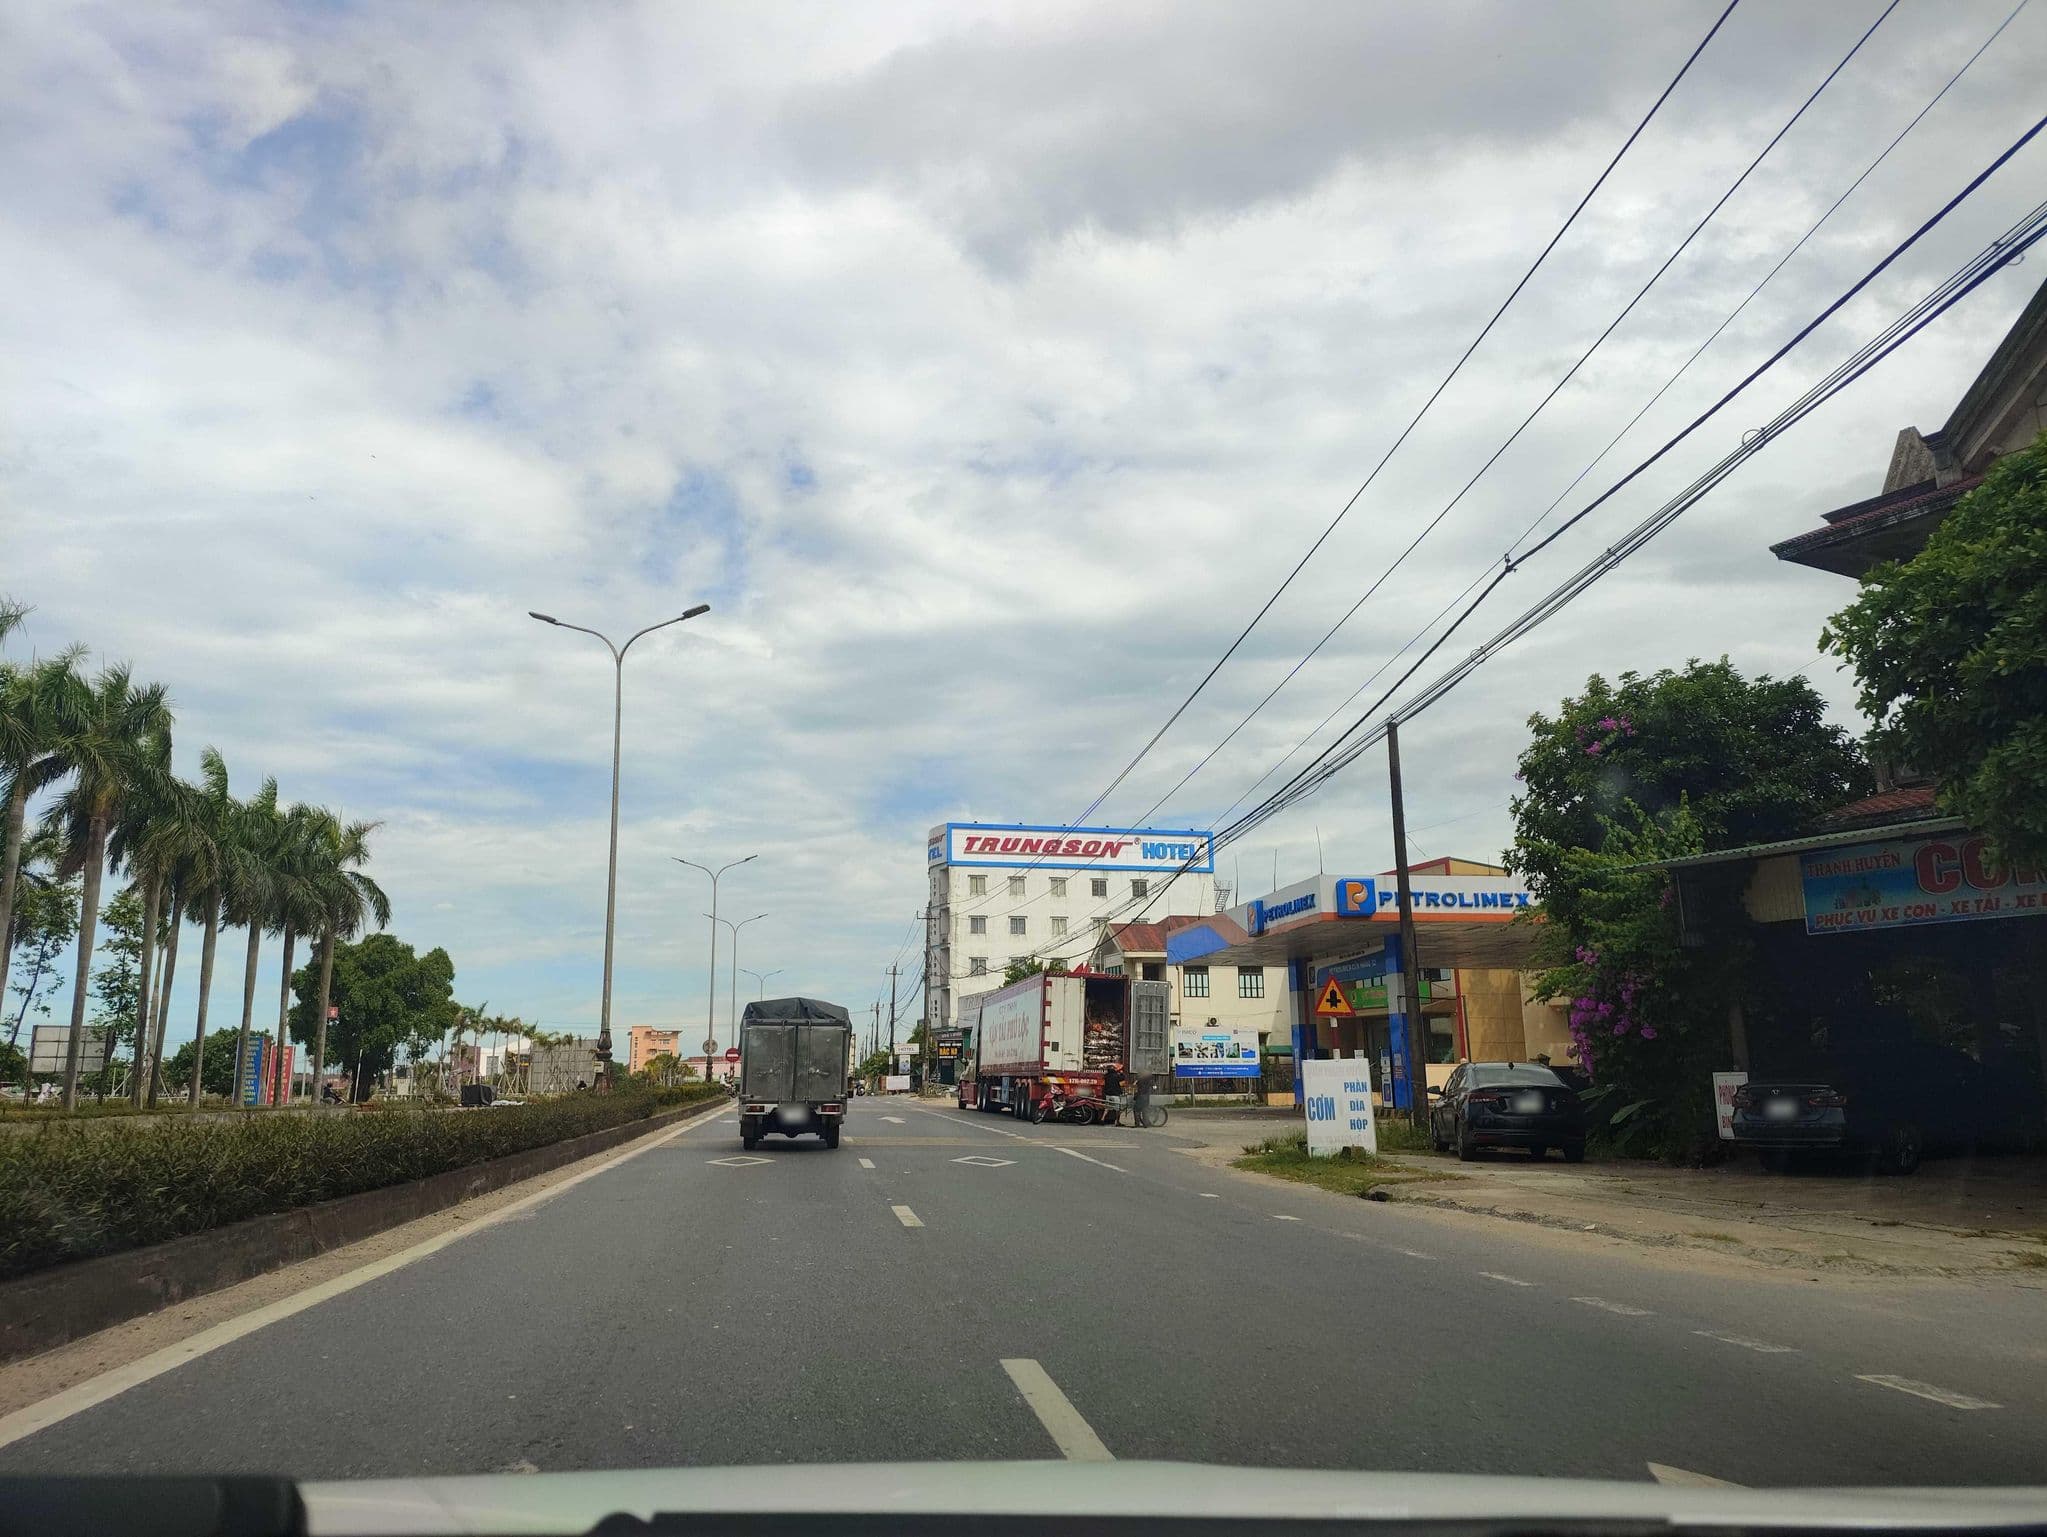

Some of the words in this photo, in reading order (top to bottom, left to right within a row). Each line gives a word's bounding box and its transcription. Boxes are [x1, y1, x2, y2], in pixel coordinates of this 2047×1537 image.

[1142, 842, 1196, 860] HOTEL
[1263, 893, 1316, 923] PETROLIMEX
[1815, 908, 1856, 929] PHỤC
[1857, 909, 1876, 929] VỤ
[1881, 907, 1899, 921] XE
[1903, 903, 1937, 919] CON
[1951, 901, 1971, 914] XE
[2014, 894, 2037, 909] XE
[1307, 1094, 1336, 1122] CƠM
